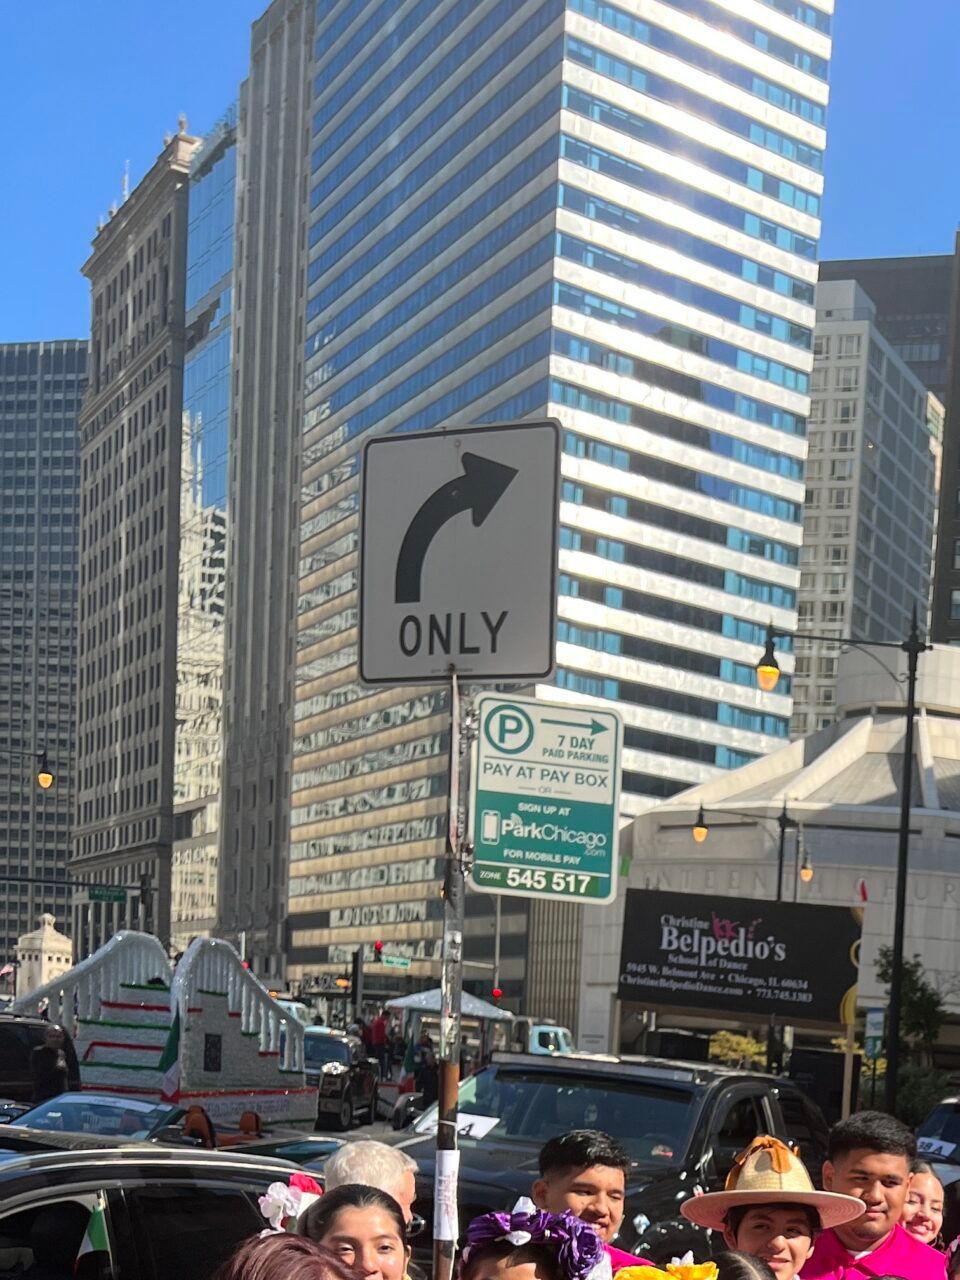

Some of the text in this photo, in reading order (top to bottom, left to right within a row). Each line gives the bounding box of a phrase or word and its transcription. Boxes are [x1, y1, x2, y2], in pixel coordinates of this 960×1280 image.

[400, 611, 508, 657] ONLY
[499, 713, 523, 744] P
[558, 735, 596, 751] 7 DAY
[542, 748, 609, 765] PAID PARKING
[483, 762, 609, 789] PAY AT PAY BOX
[538, 786, 552, 796] OR
[518, 802, 572, 817] SIGN UP AT
[501, 819, 607, 849] ParkChicago
[503, 848, 581, 866] FOR MOBILE PAY
[480, 868, 591, 894] ZONE 545 517
[660, 914, 710, 931] Christine
[660, 925, 786, 967] Belpedio's
[667, 953, 748, 971] School of Dance
[662, 966, 698, 979] Belmont
[728, 972, 767, 988] Chicago,
